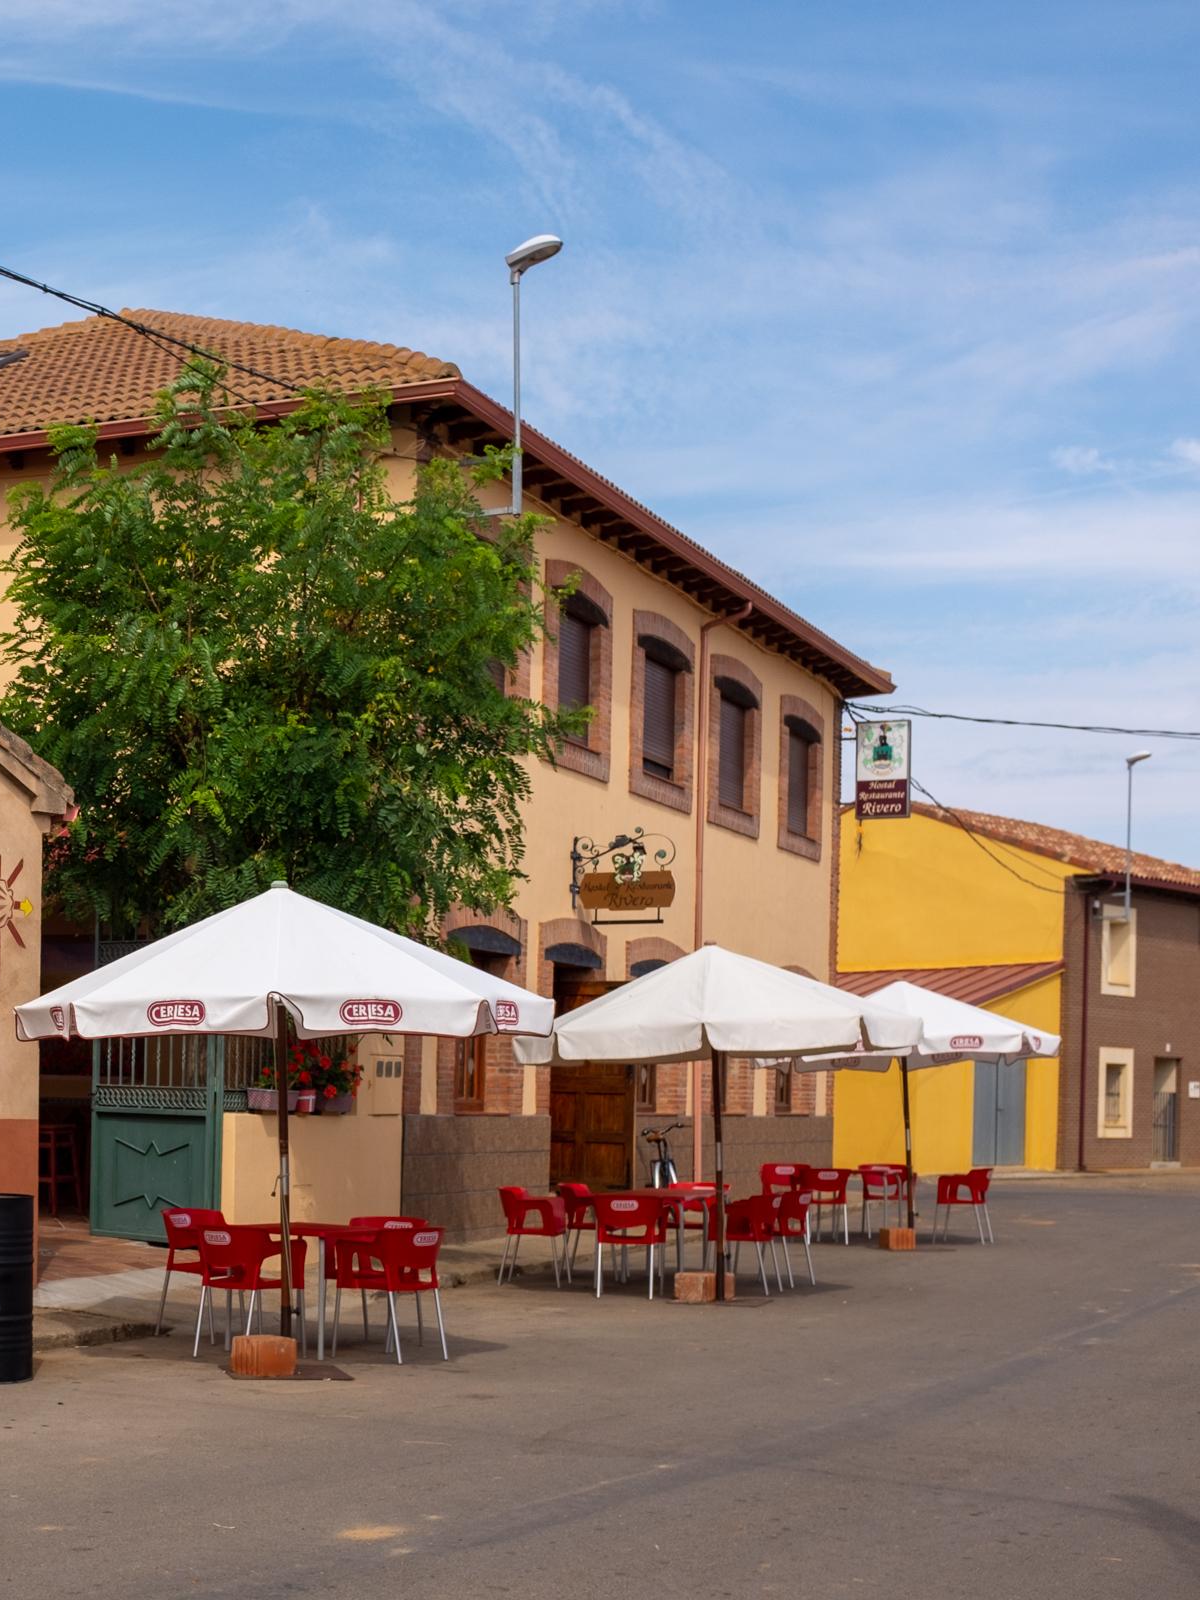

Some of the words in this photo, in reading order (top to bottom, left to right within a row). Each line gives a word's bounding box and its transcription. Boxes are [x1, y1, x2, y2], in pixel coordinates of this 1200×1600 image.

[867, 781, 896, 790] Hostal
[858, 791, 905, 801] Restaurante
[862, 802, 902, 815] Rivero
[604, 893, 654, 908] Rivero
[151, 1004, 200, 1021] CERLESA
[343, 1003, 395, 1021] CERLESA
